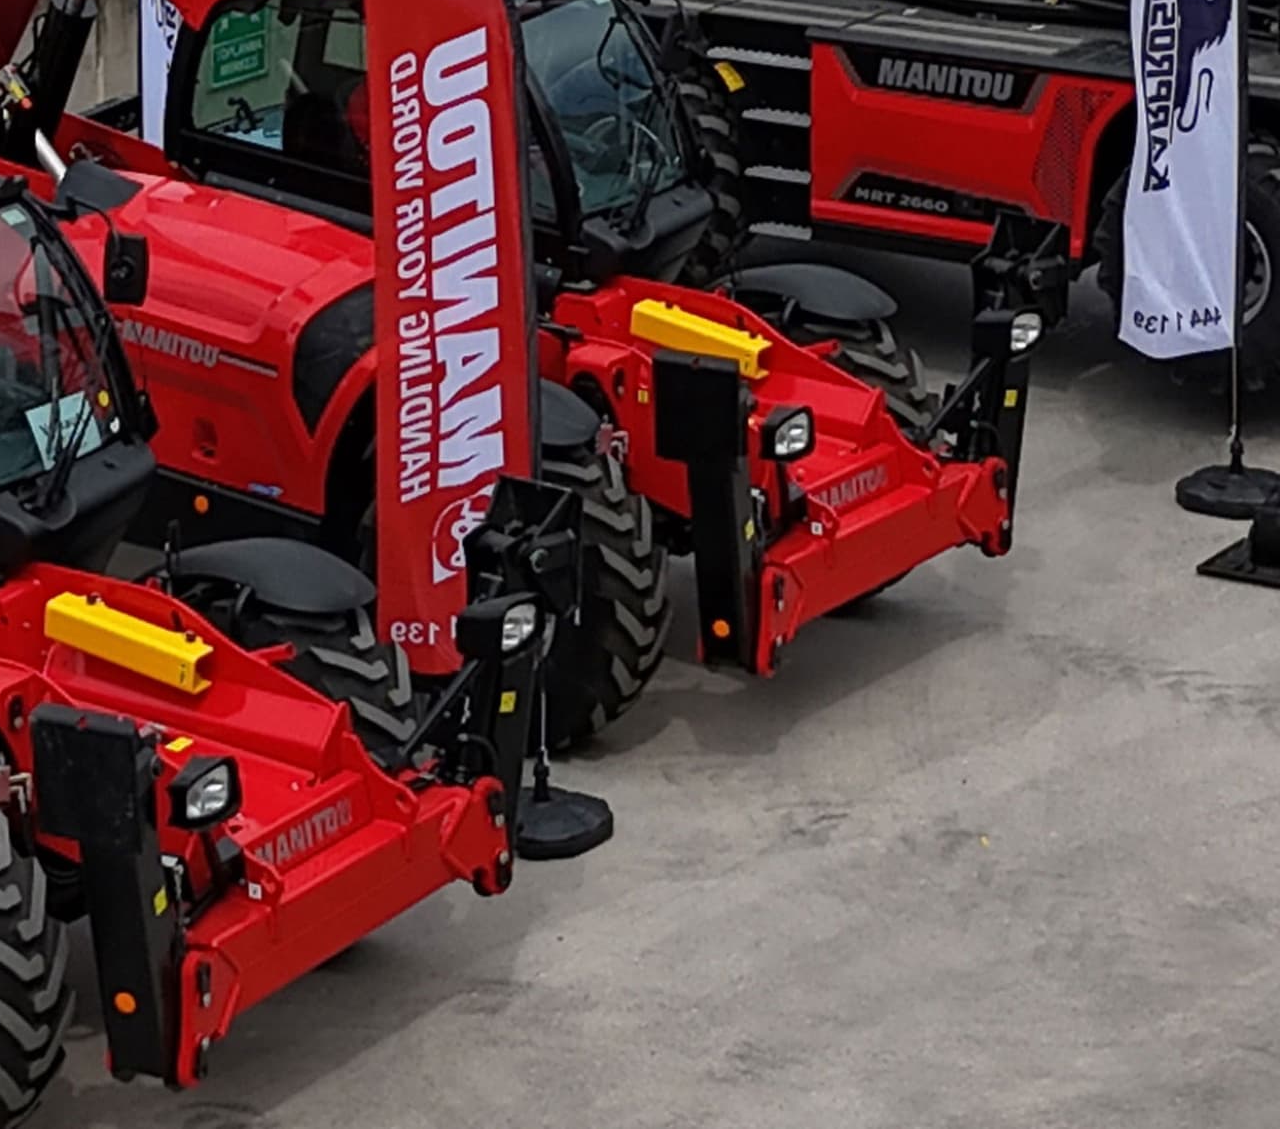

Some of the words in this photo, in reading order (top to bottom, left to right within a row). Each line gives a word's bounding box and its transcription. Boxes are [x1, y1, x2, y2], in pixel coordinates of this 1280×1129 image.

[877, 57, 1015, 102] MANITOU
[854, 186, 896, 204] MRT
[122, 318, 220, 369] MANITOU
[254, 796, 353, 868] MANITOU
